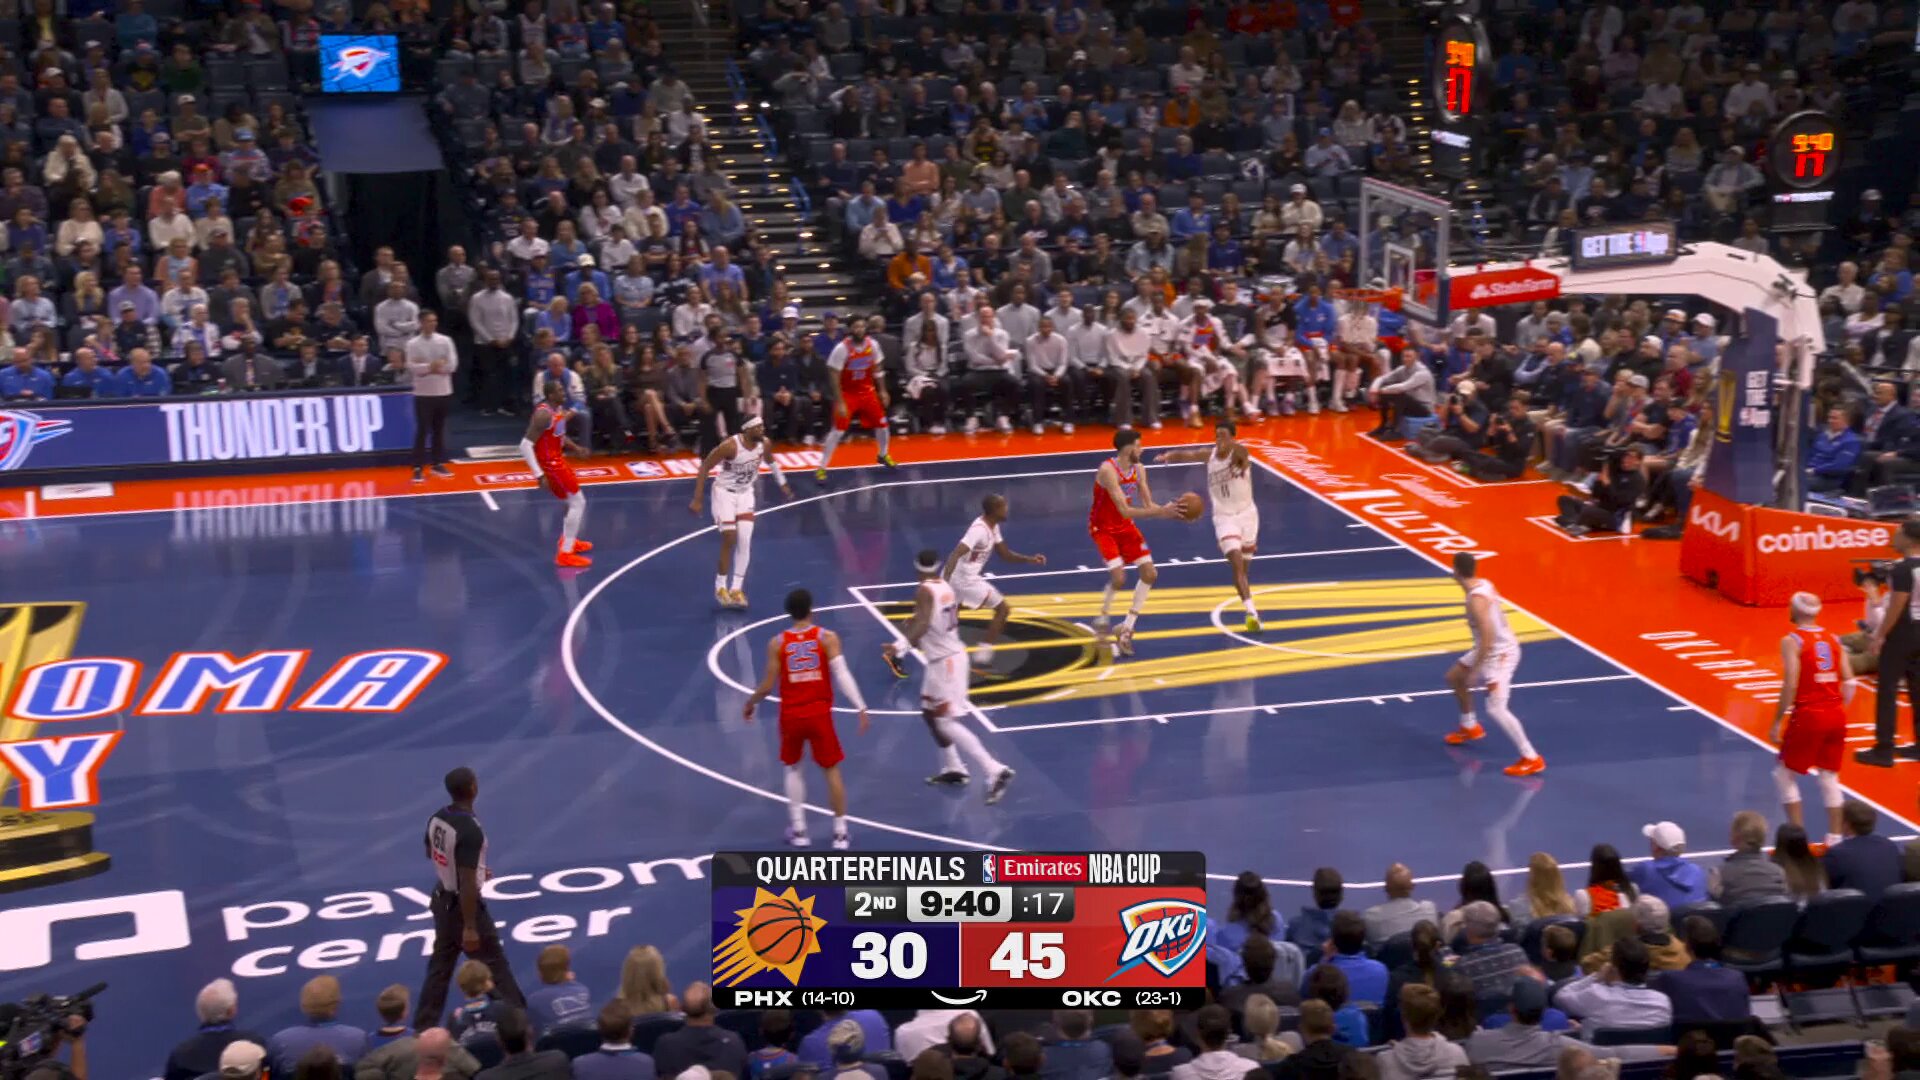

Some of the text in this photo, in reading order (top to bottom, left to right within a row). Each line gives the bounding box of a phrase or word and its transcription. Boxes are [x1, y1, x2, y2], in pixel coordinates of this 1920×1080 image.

[159, 395, 384, 463] THUNDER UP
[1757, 524, 1889, 553] coinbase
[785, 640, 821, 672] 25
[1638, 630, 1785, 704] OKLAHO
[1815, 641, 1833, 671] 9
[231, 905, 632, 977] cener
